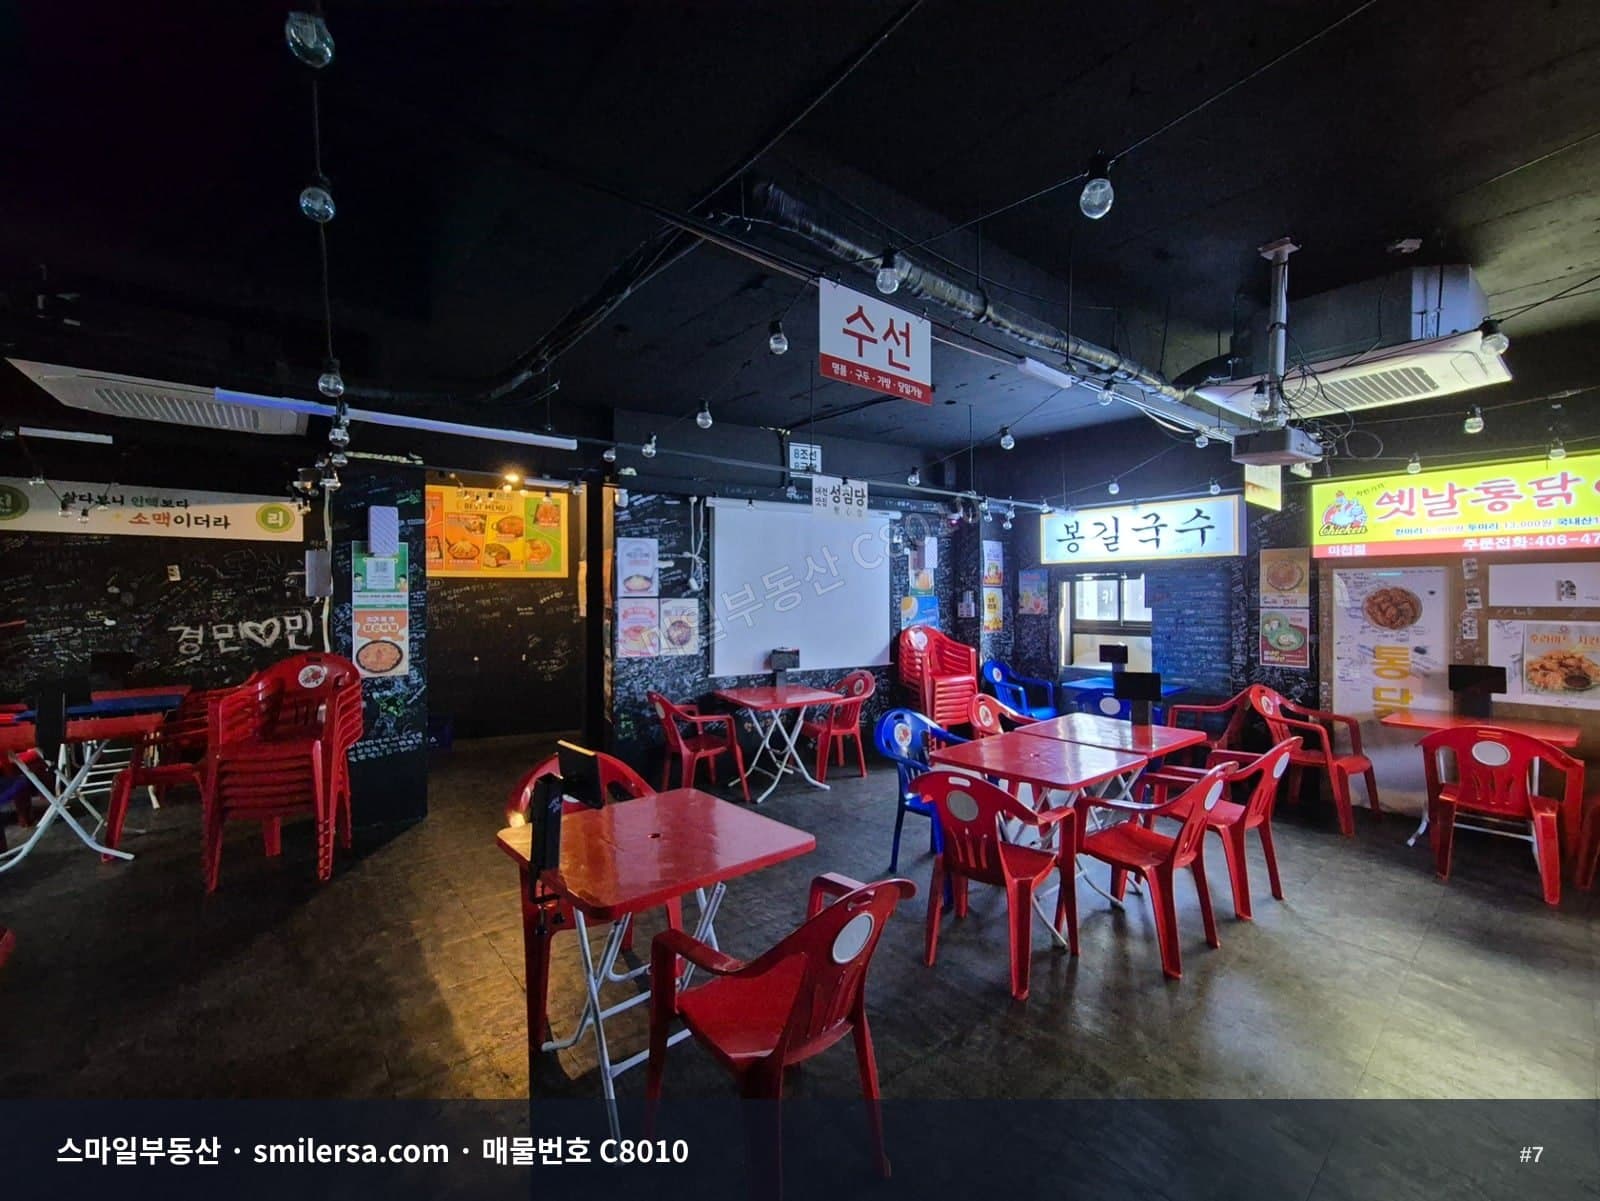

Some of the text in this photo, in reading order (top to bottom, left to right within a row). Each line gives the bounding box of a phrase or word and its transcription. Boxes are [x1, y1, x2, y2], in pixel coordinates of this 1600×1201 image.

[842, 305, 911, 372] 수선
[855, 368, 871, 383] 구두
[877, 375, 892, 389] 가방
[62, 491, 125, 507] 살다보니
[830, 484, 866, 507] 성심당
[1375, 471, 1582, 520] 옛날통닭
[128, 511, 231, 530] 소맥이더라
[266, 511, 284, 527] 리
[1056, 508, 1215, 553] 봉길국수
[1319, 523, 1368, 537] Chicken
